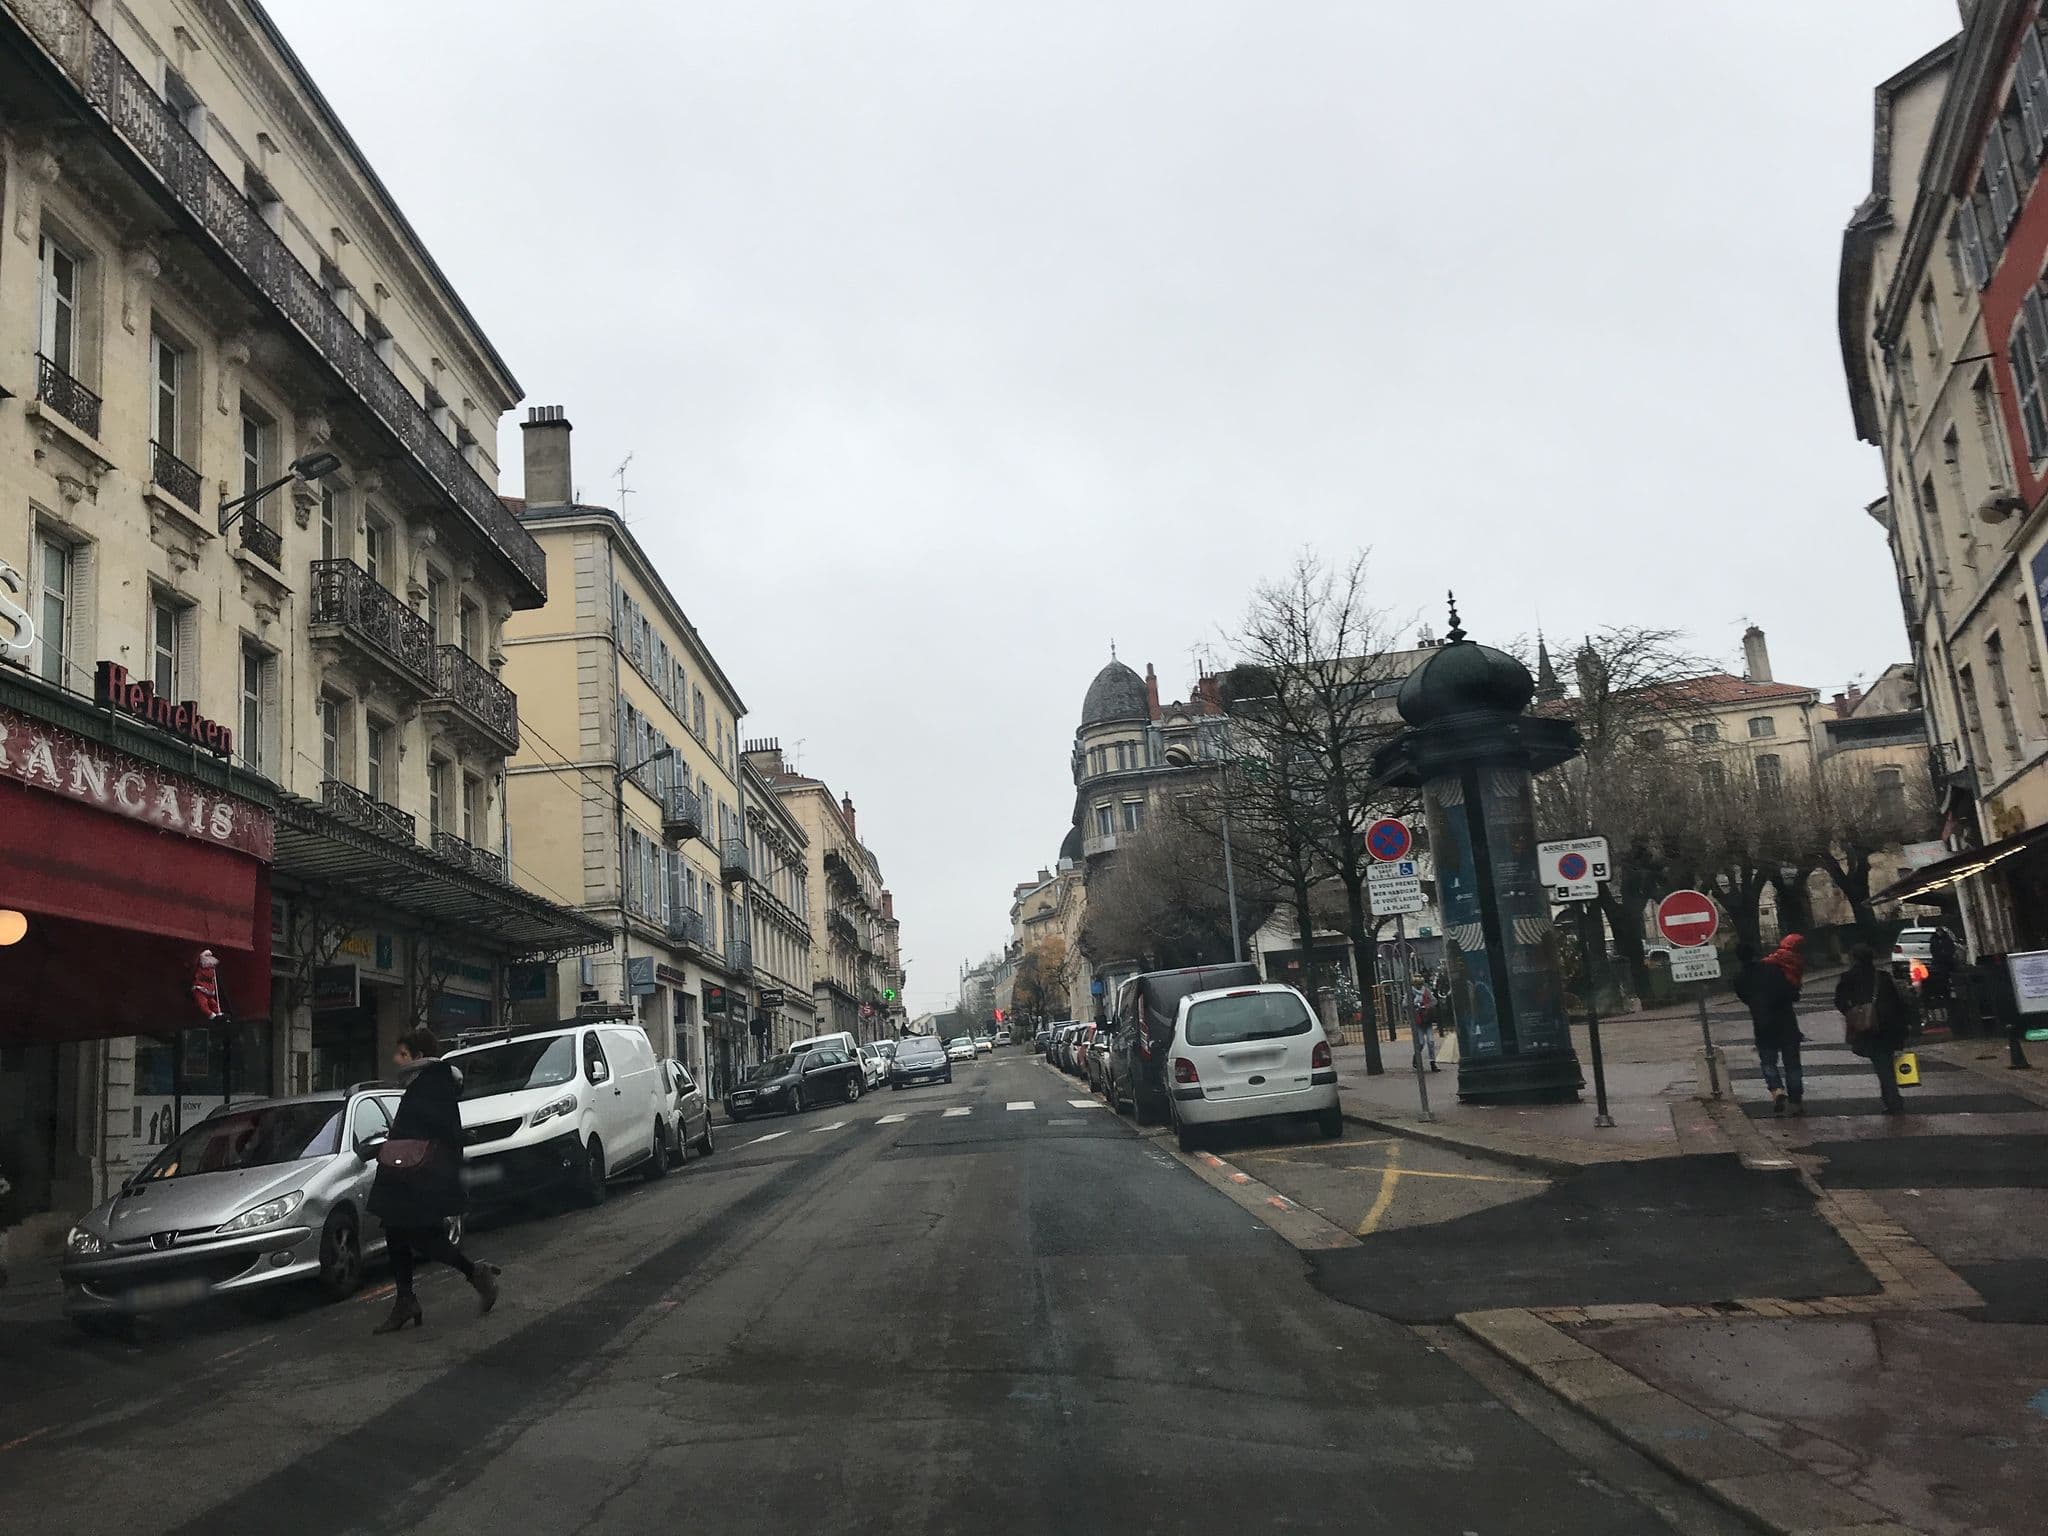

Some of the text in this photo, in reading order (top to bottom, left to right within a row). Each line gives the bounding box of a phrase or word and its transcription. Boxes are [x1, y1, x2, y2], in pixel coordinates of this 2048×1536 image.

[97, 661, 234, 753] Heineken
[1572, 840, 1603, 849] MINUTE
[183, 1102, 201, 1110] SONY
